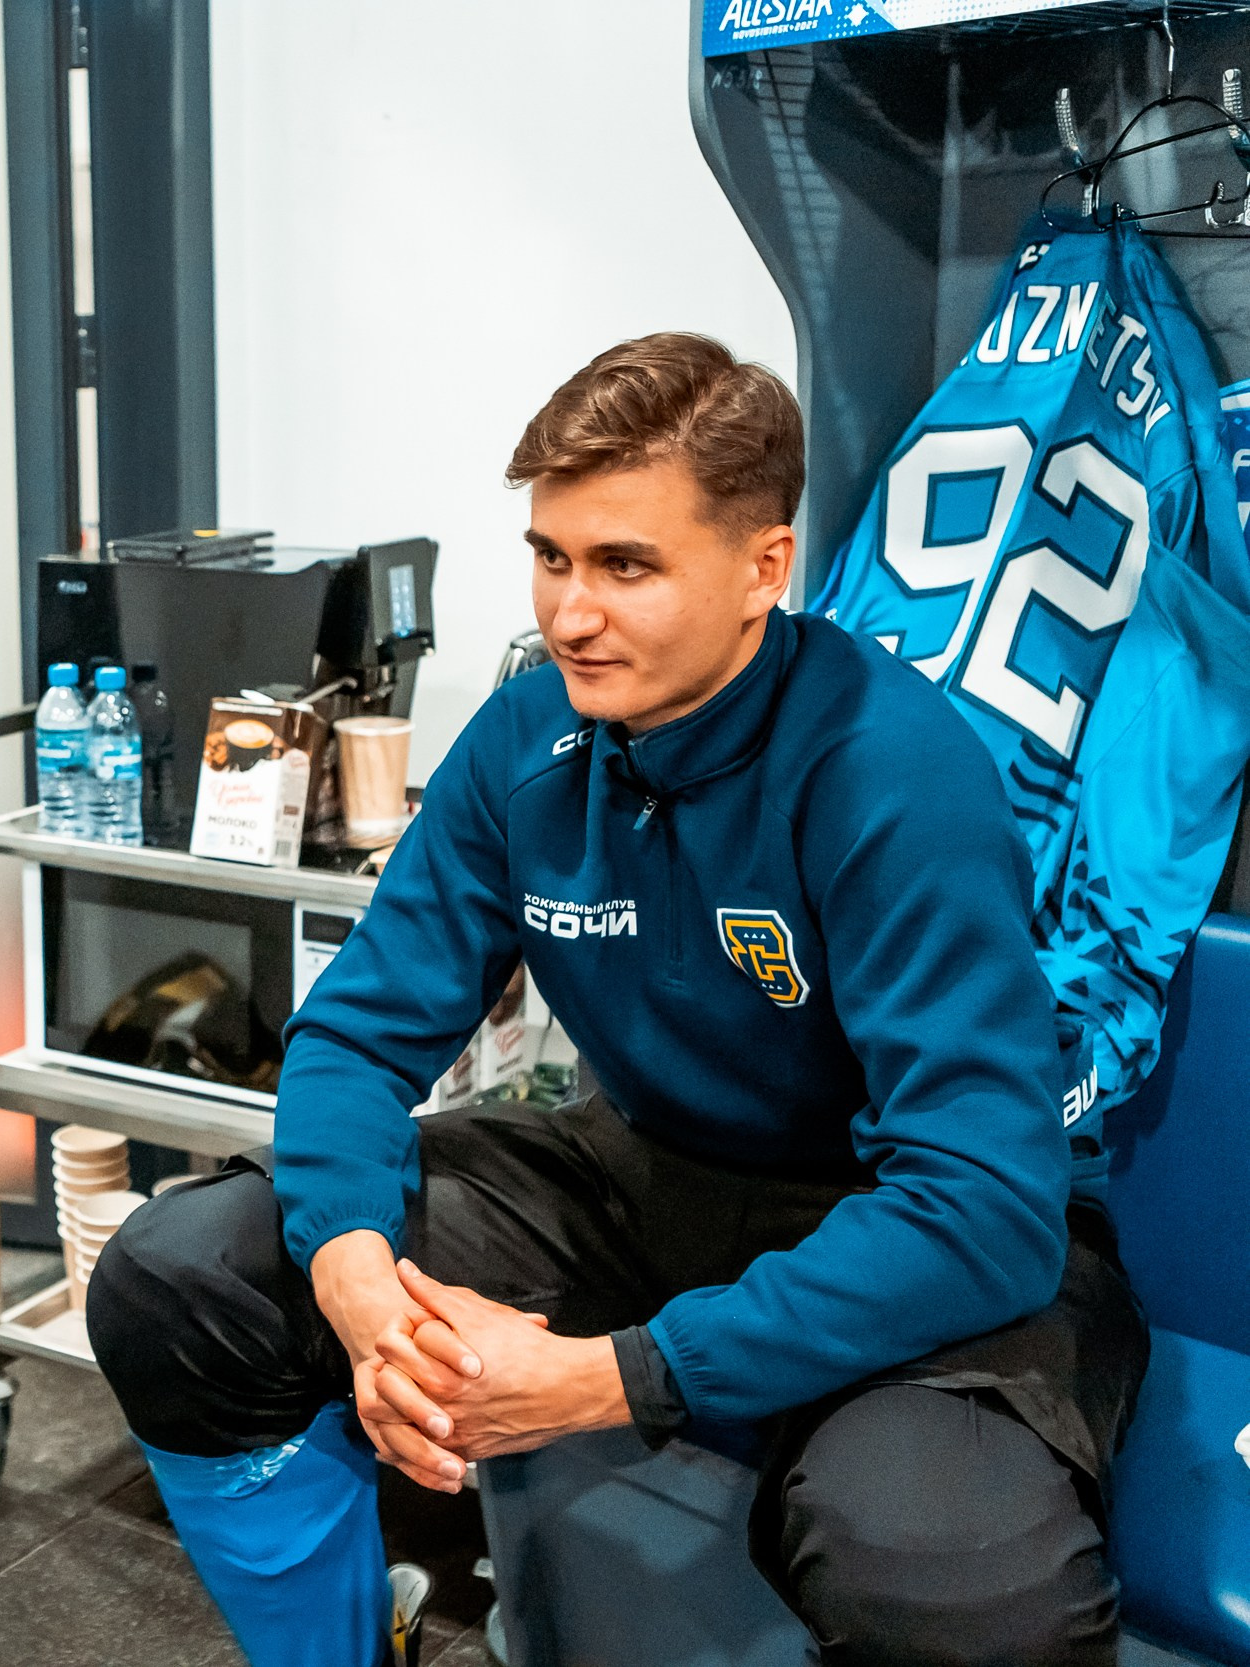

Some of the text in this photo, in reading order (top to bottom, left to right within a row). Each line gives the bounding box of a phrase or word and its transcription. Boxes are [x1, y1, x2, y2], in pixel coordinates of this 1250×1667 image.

[879, 422, 1152, 759] 92
[524, 892, 636, 915] ХОККЕЙНЫЙ КЛУБ
[524, 904, 638, 940] СОЧИ
